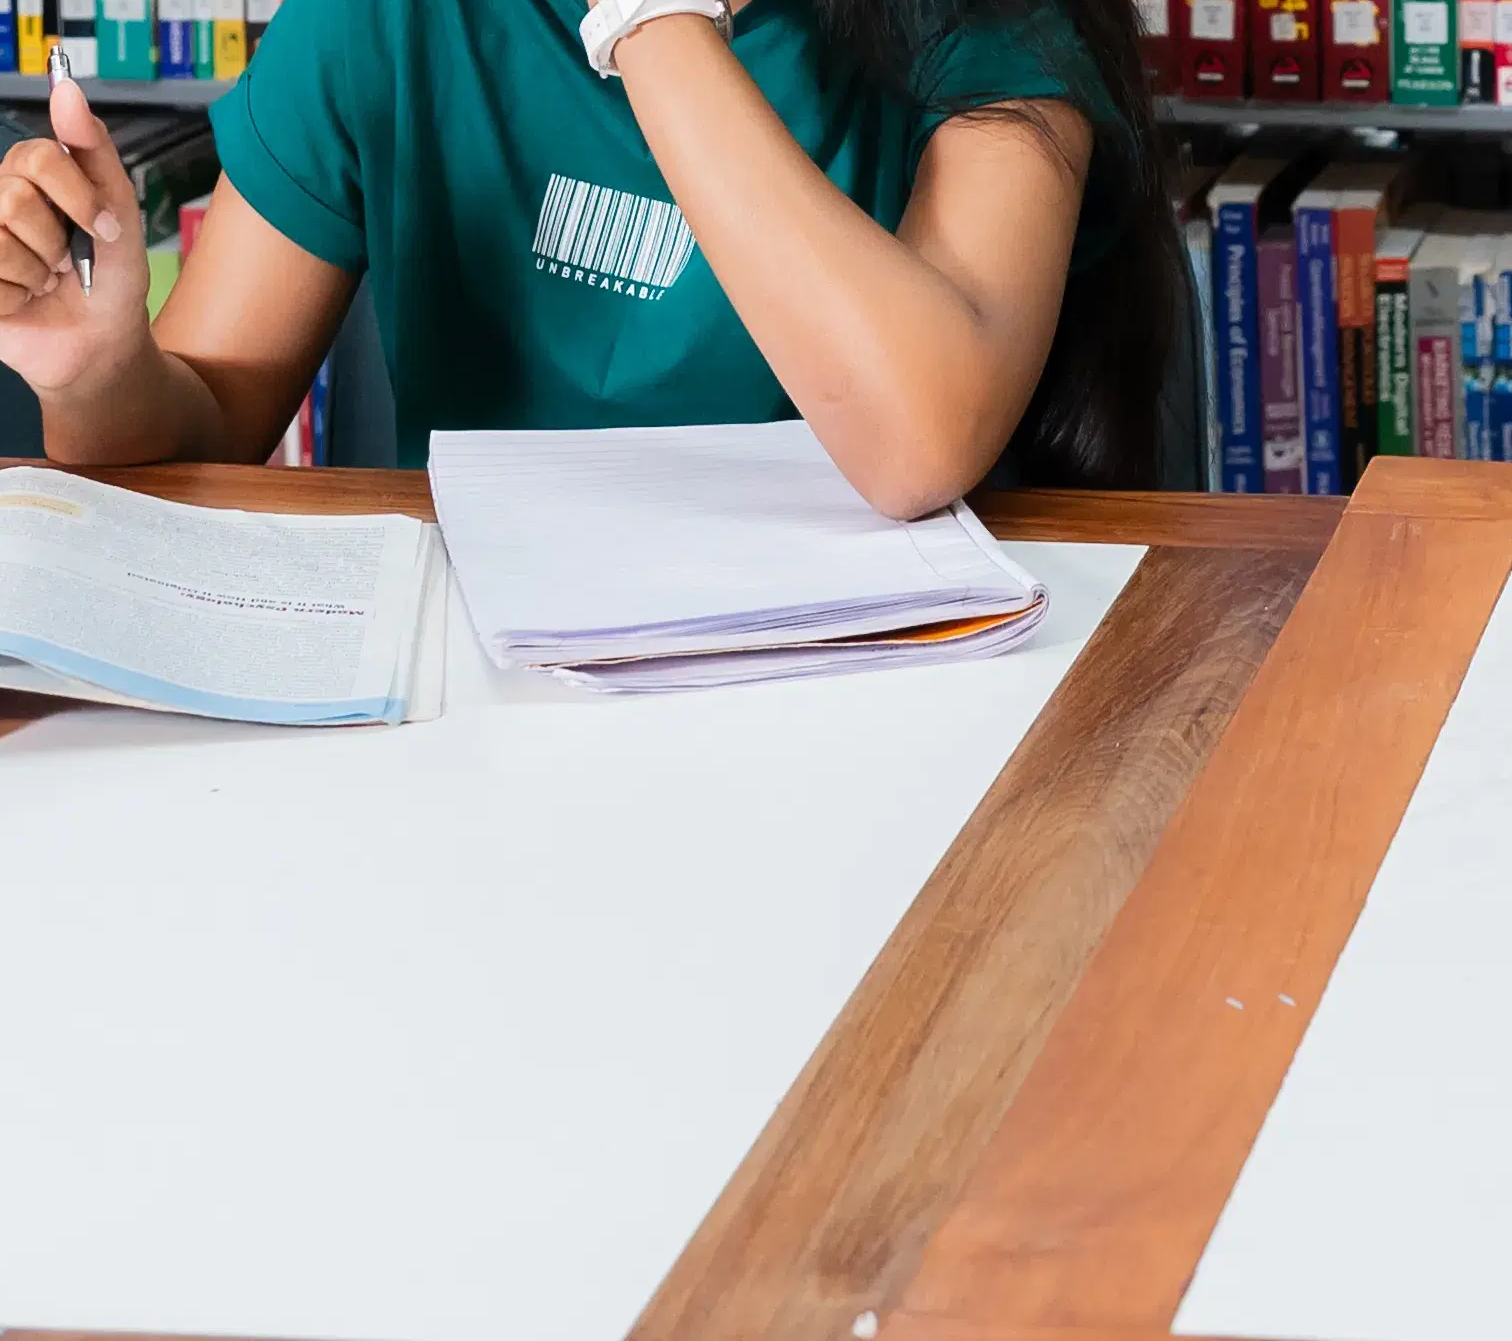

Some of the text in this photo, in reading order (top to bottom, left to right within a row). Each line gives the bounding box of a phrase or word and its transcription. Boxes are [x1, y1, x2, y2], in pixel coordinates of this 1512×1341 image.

[1229, 245, 1248, 434] Principles of Economics
